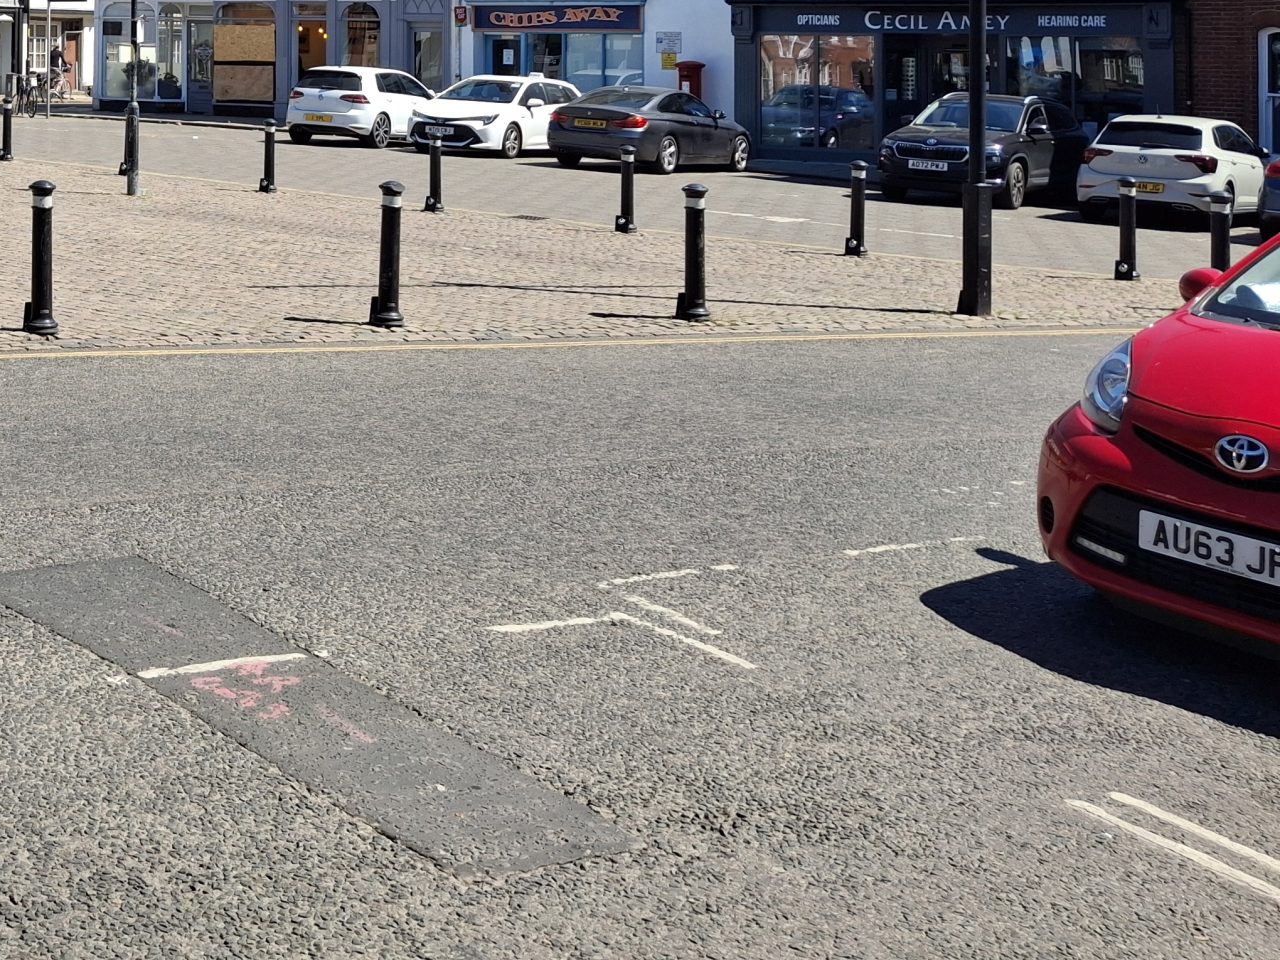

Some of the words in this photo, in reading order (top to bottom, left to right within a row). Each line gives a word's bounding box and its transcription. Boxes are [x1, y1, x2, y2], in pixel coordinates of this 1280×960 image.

[559, 7, 624, 23] AWAY
[797, 15, 840, 26] OPTICIANS
[864, 11, 928, 30] CECIL
[1038, 15, 1079, 27] HEARING
[1081, 16, 1107, 27] CARE
[1152, 519, 1235, 567] AU63
